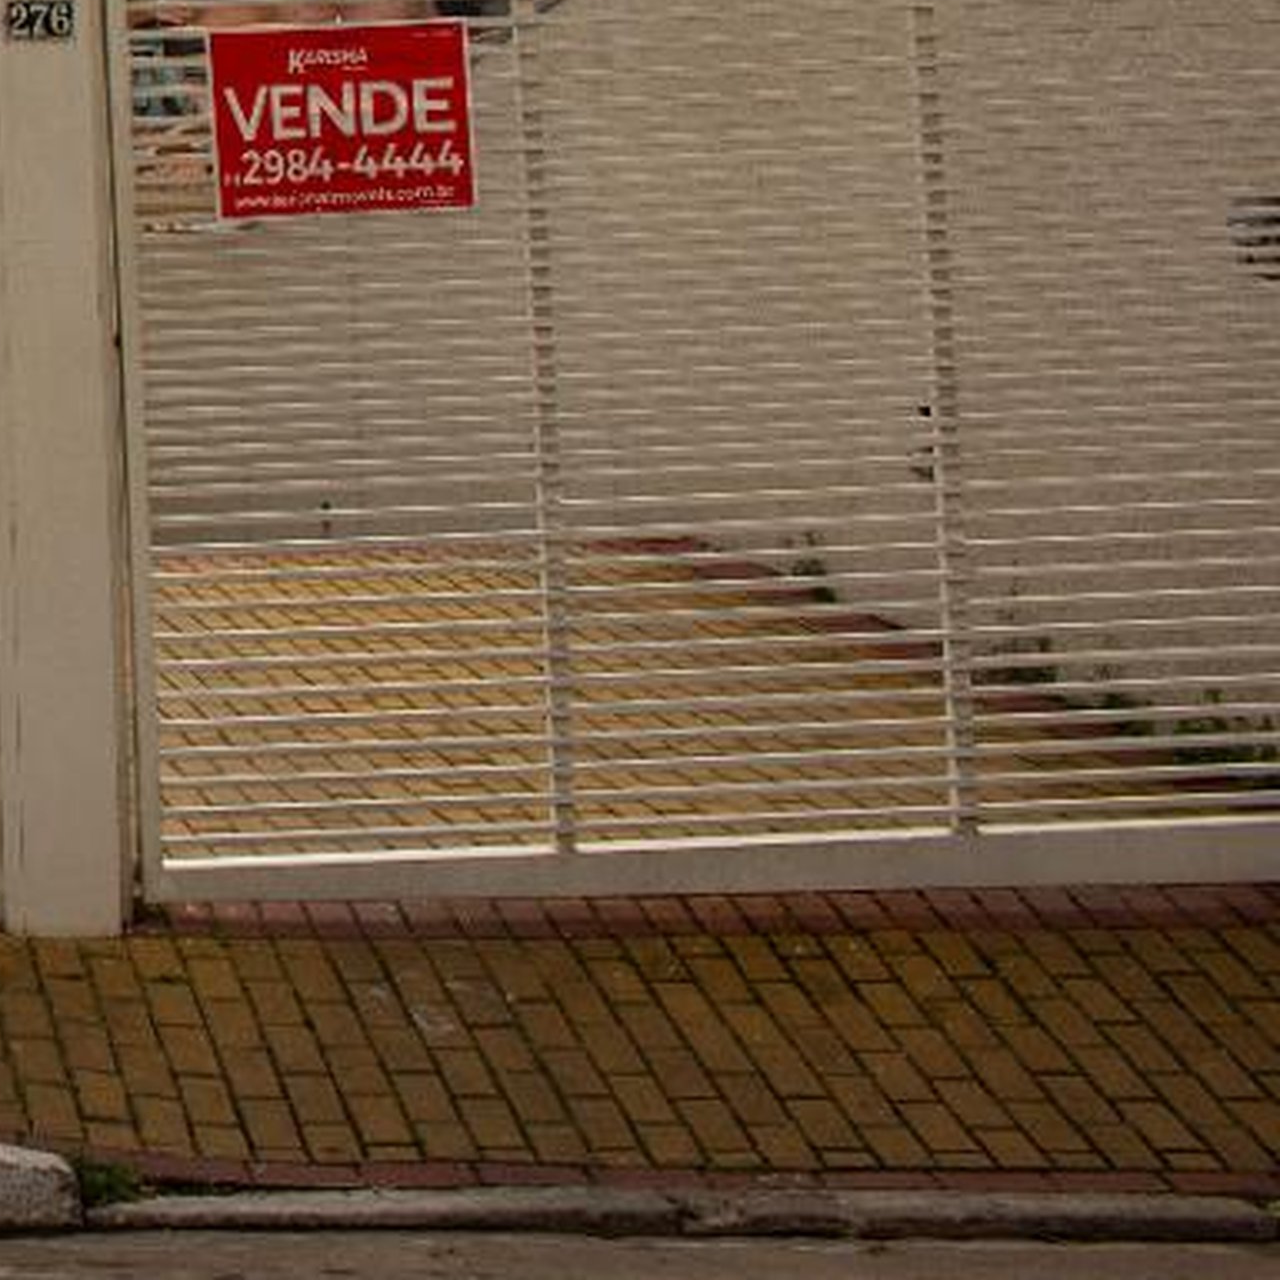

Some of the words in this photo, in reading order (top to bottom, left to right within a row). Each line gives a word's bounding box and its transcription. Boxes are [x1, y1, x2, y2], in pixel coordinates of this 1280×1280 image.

[10, 1, 70, 36] 276
[223, 75, 458, 142] VENDE
[240, 138, 465, 187] 2984-4444
